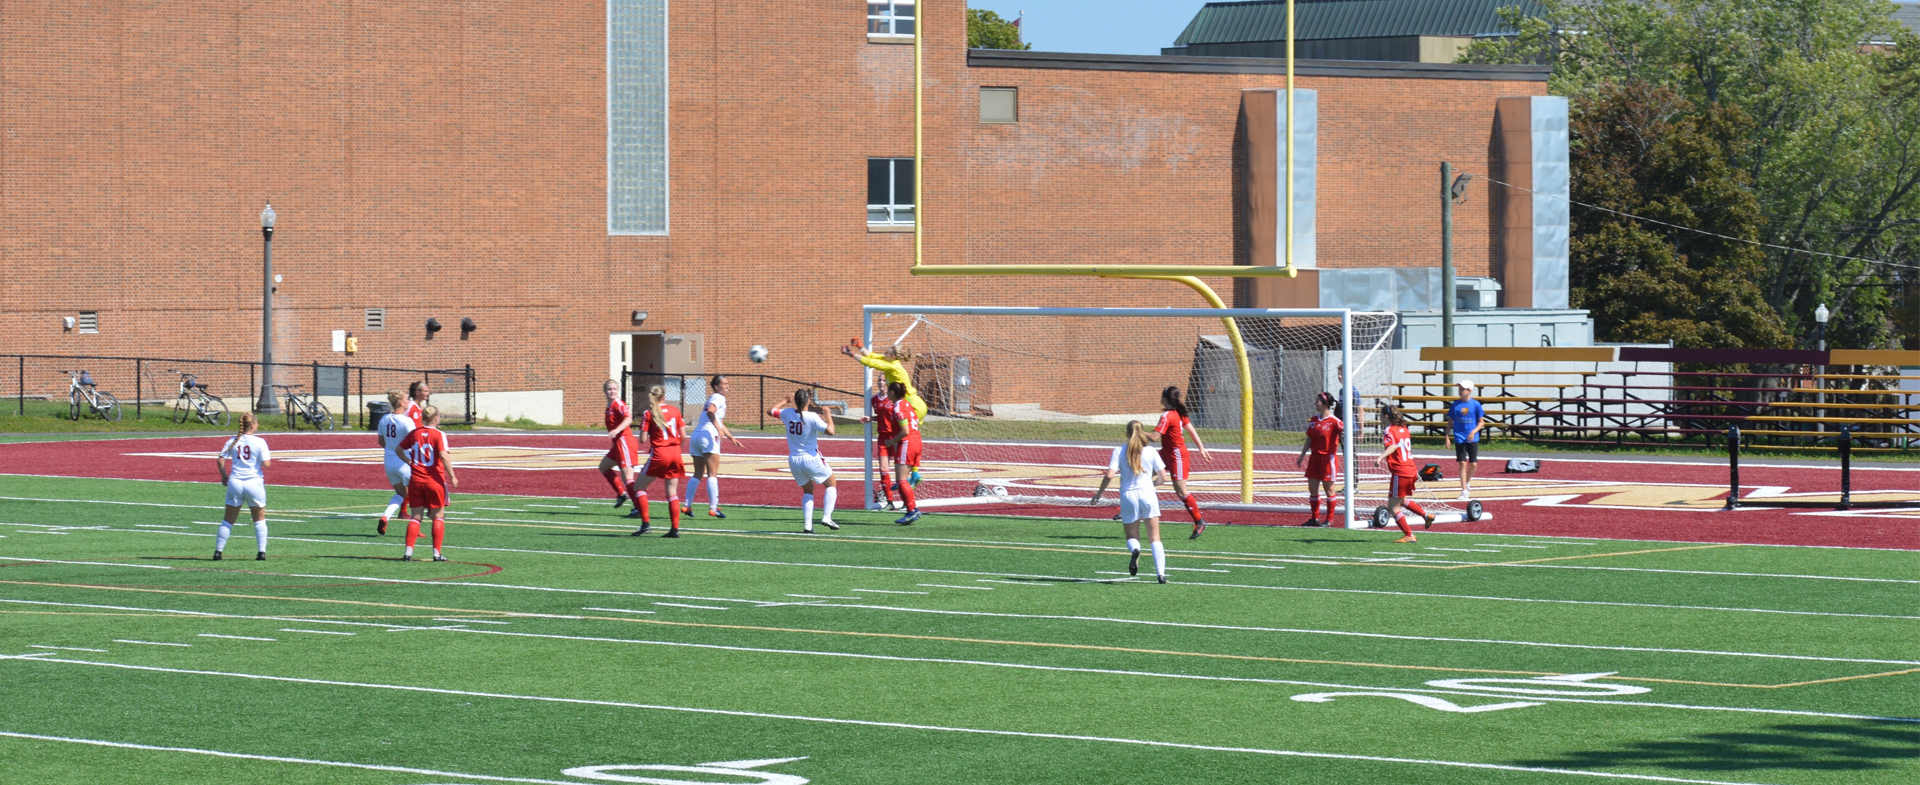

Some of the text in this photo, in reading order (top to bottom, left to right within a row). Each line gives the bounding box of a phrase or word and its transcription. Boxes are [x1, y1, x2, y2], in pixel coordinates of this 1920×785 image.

[385, 423, 398, 438] 18
[789, 421, 803, 435] 20
[236, 445, 251, 460] 19
[411, 441, 435, 467] 10
[1289, 677, 1652, 713] 20
